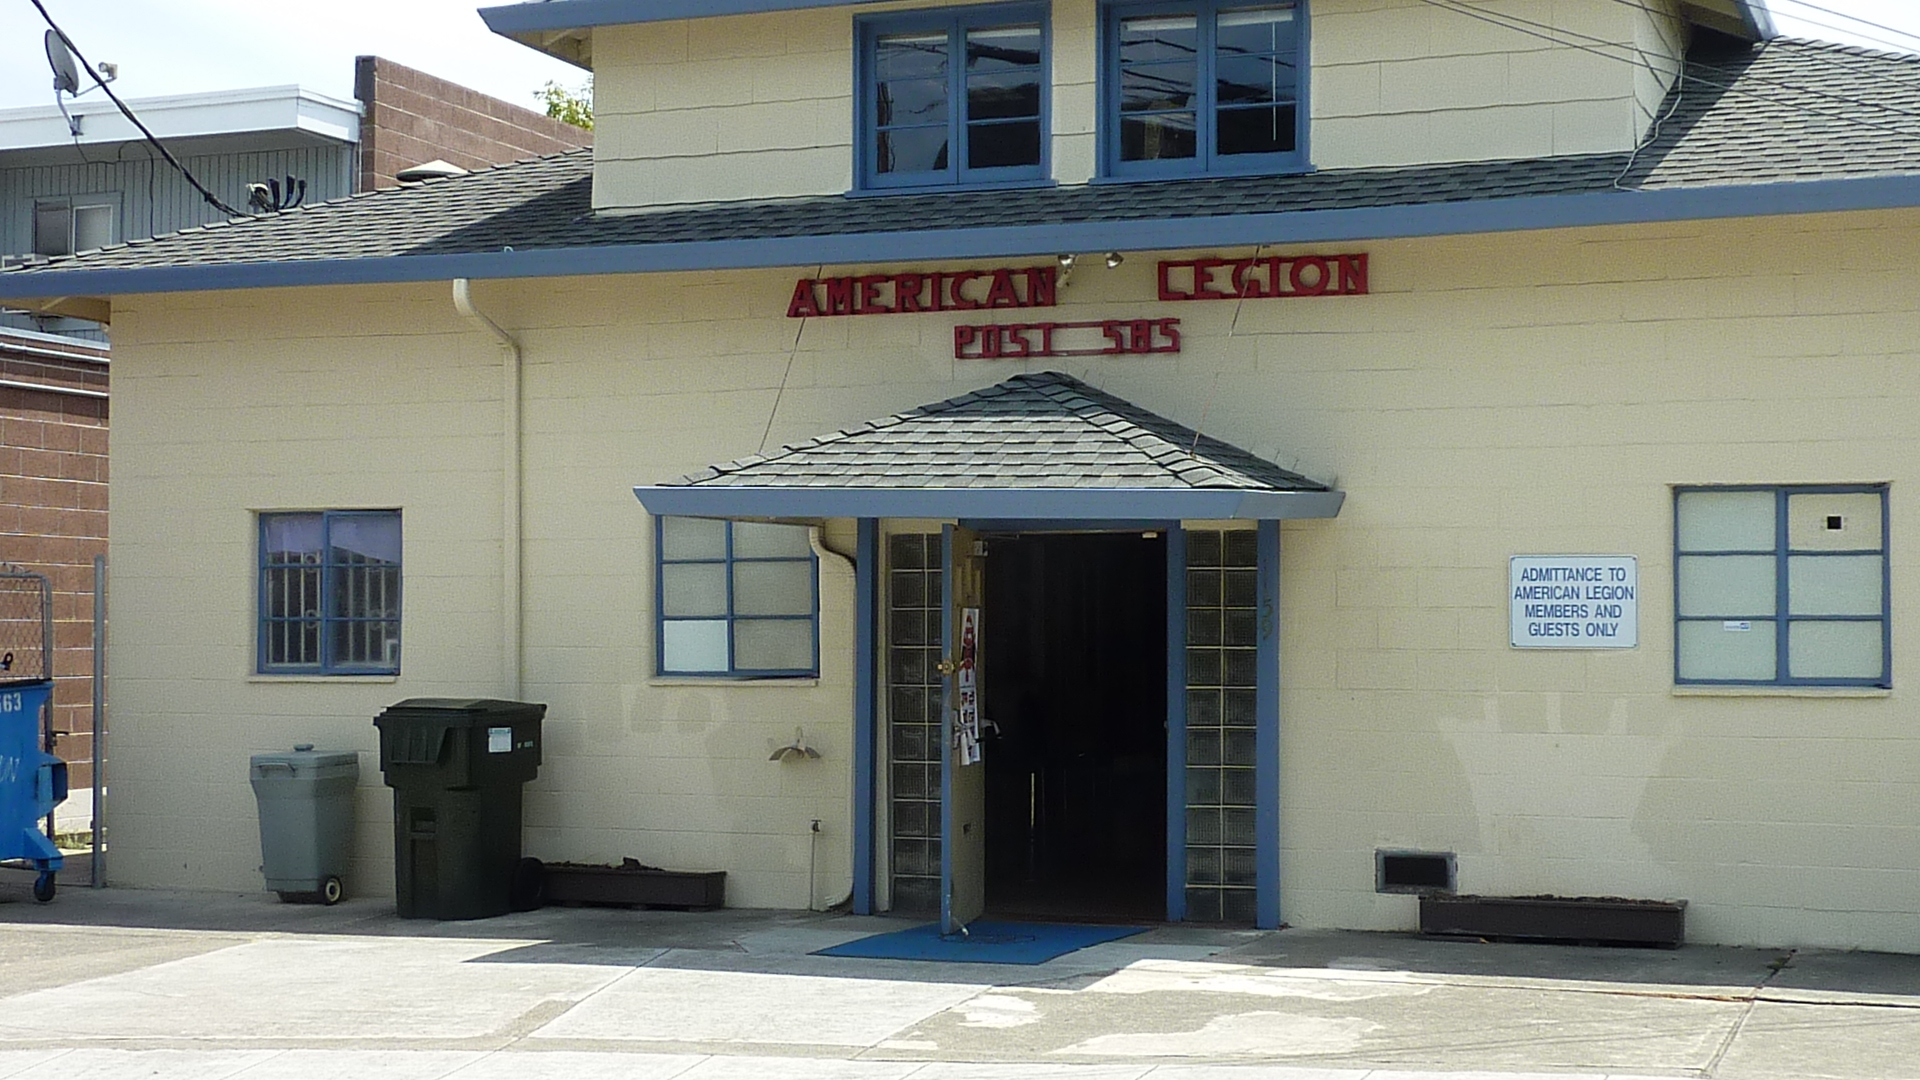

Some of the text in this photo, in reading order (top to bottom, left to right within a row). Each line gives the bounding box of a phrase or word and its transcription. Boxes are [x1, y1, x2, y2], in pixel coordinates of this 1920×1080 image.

[787, 252, 1369, 317] AMERICAN LEGION
[954, 318, 1181, 359] POST 585
[1521, 567, 1626, 582] ADMITTANCE TO
[1514, 586, 1634, 600] AMERICAN LEGION
[1525, 604, 1622, 618] MEMBERS AND
[1528, 622, 1619, 637] GUESTS ONLY
[0, 692, 22, 713] 63
